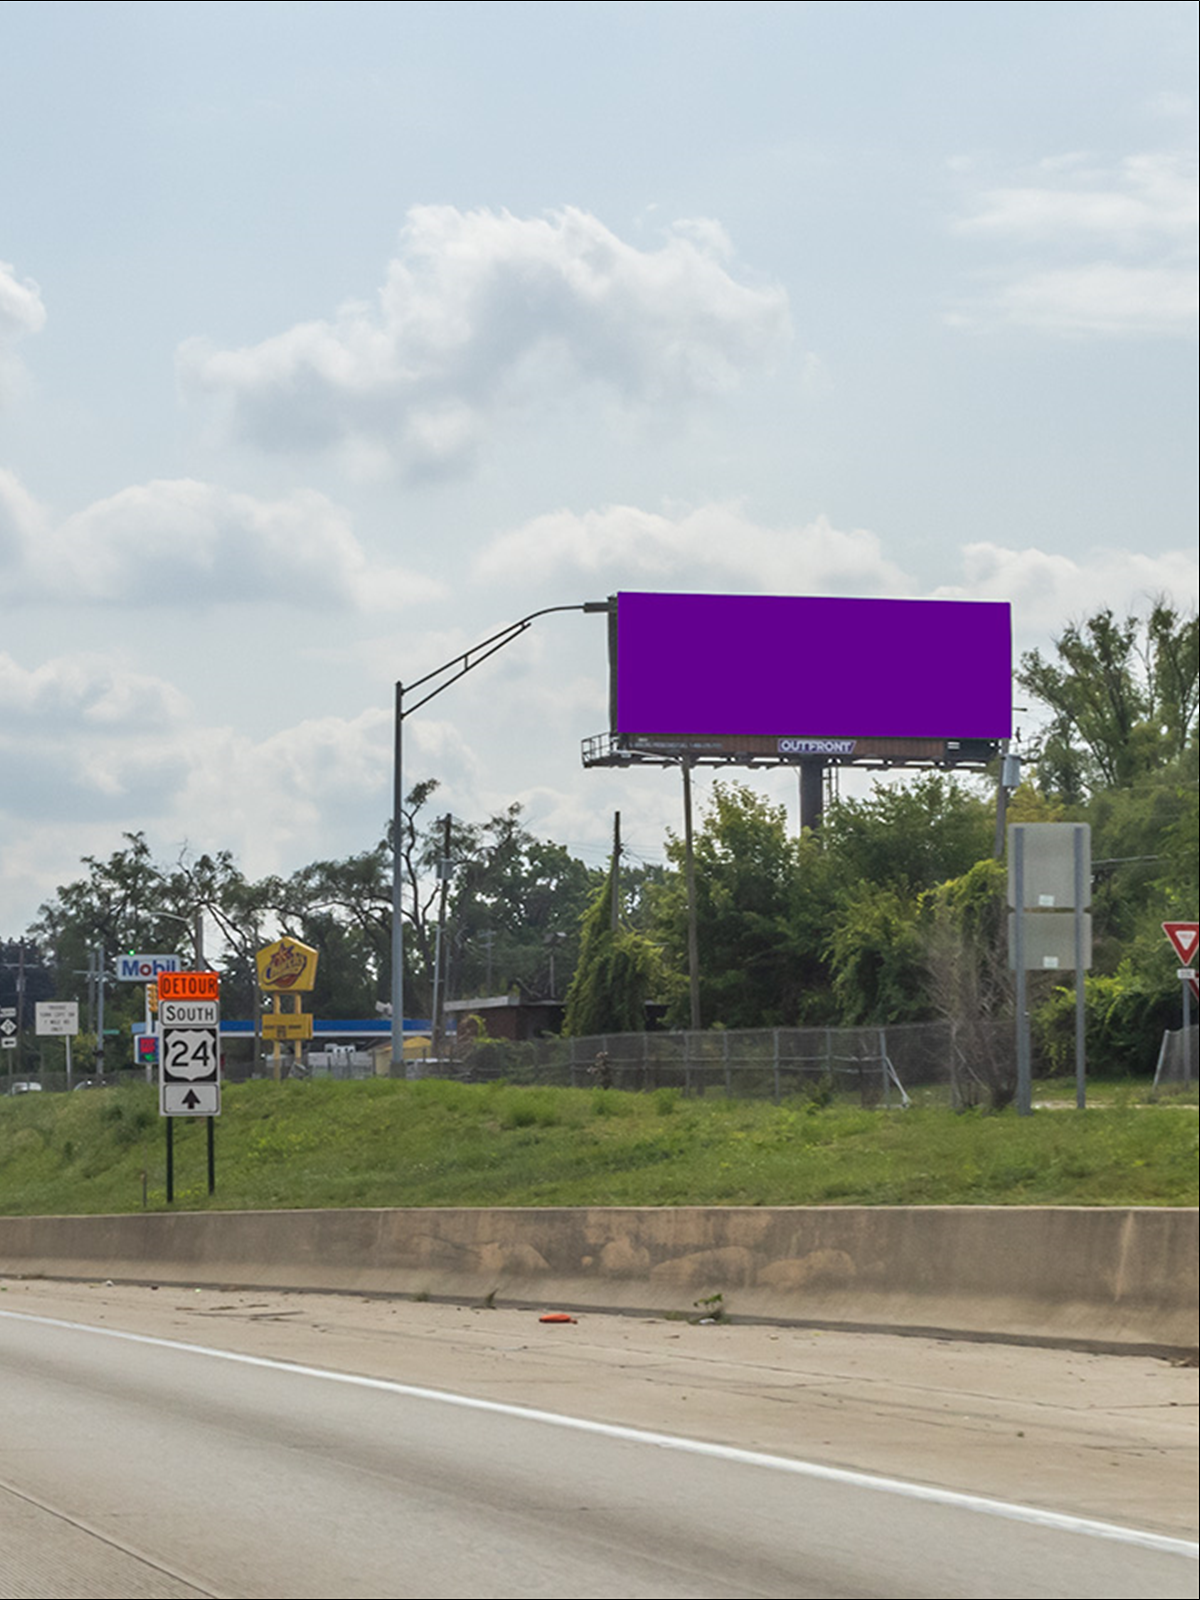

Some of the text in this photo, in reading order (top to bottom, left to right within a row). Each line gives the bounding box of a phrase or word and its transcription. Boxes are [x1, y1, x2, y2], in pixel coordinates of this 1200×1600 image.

[781, 740, 852, 753] OUTFRONT
[122, 959, 176, 977] Mobil
[162, 977, 216, 995] DETOUR
[166, 1005, 214, 1022] SOUTH
[171, 1040, 210, 1067] 24
